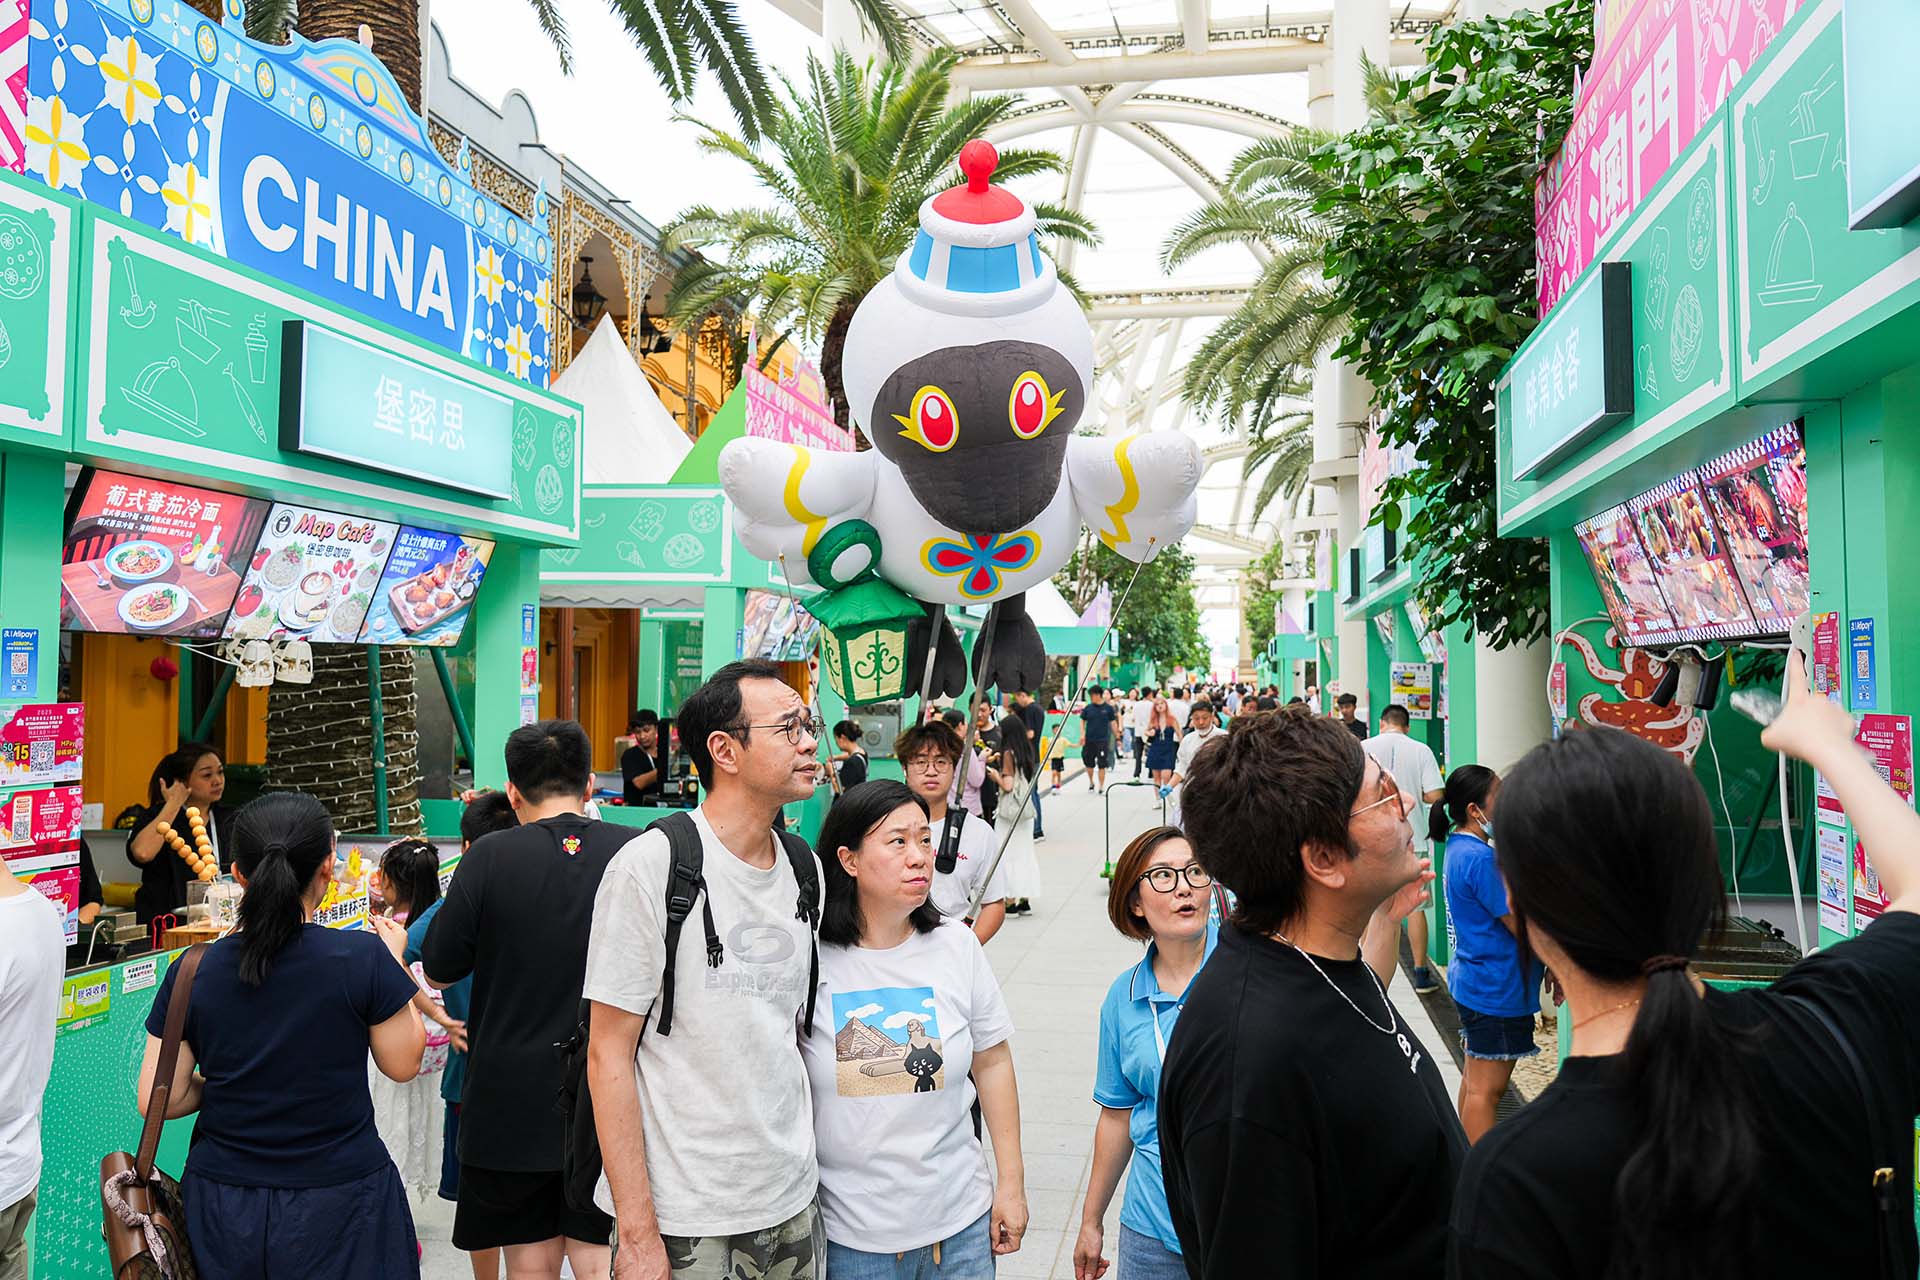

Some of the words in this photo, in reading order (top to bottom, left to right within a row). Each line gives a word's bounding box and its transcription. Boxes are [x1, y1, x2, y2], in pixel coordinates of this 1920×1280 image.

[1588, 23, 1680, 259] 澳門
[242, 154, 456, 331] CHINA
[373, 373, 465, 450] 堡密思
[106, 484, 221, 522] 葡式蕃茄冷面
[293, 513, 335, 541] Map
[337, 520, 376, 544] Café
[2, 742, 13, 752] 50
[14, 744, 29, 760] 15
